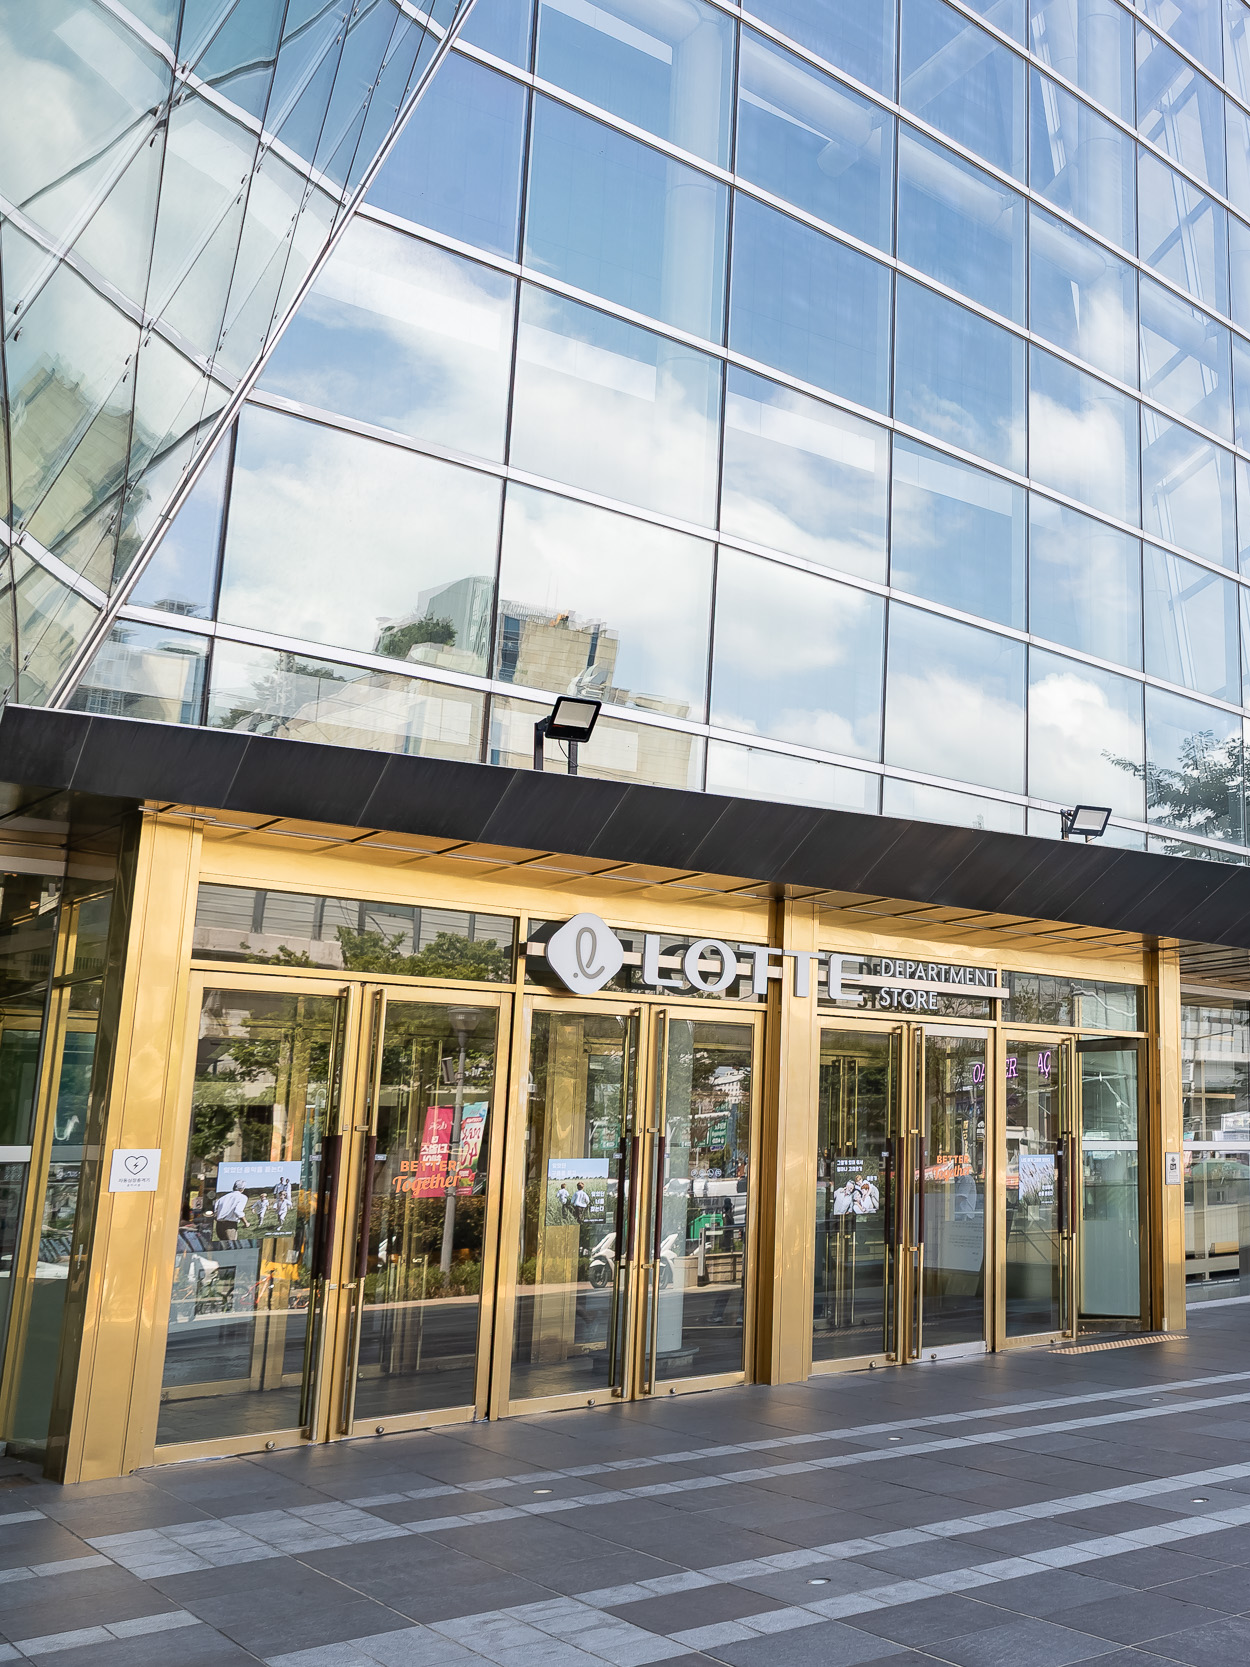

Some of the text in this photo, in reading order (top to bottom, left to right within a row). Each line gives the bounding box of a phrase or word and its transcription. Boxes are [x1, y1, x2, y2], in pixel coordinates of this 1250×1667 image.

[643, 934, 865, 1001] LOTTE
[880, 958, 998, 988] DEPARTMENT
[879, 987, 938, 1010] STORE
[400, 1160, 457, 1172] BETTER
[936, 1155, 969, 1164] BETTER
[392, 1173, 461, 1196] Together
[932, 1165, 972, 1182] Together
